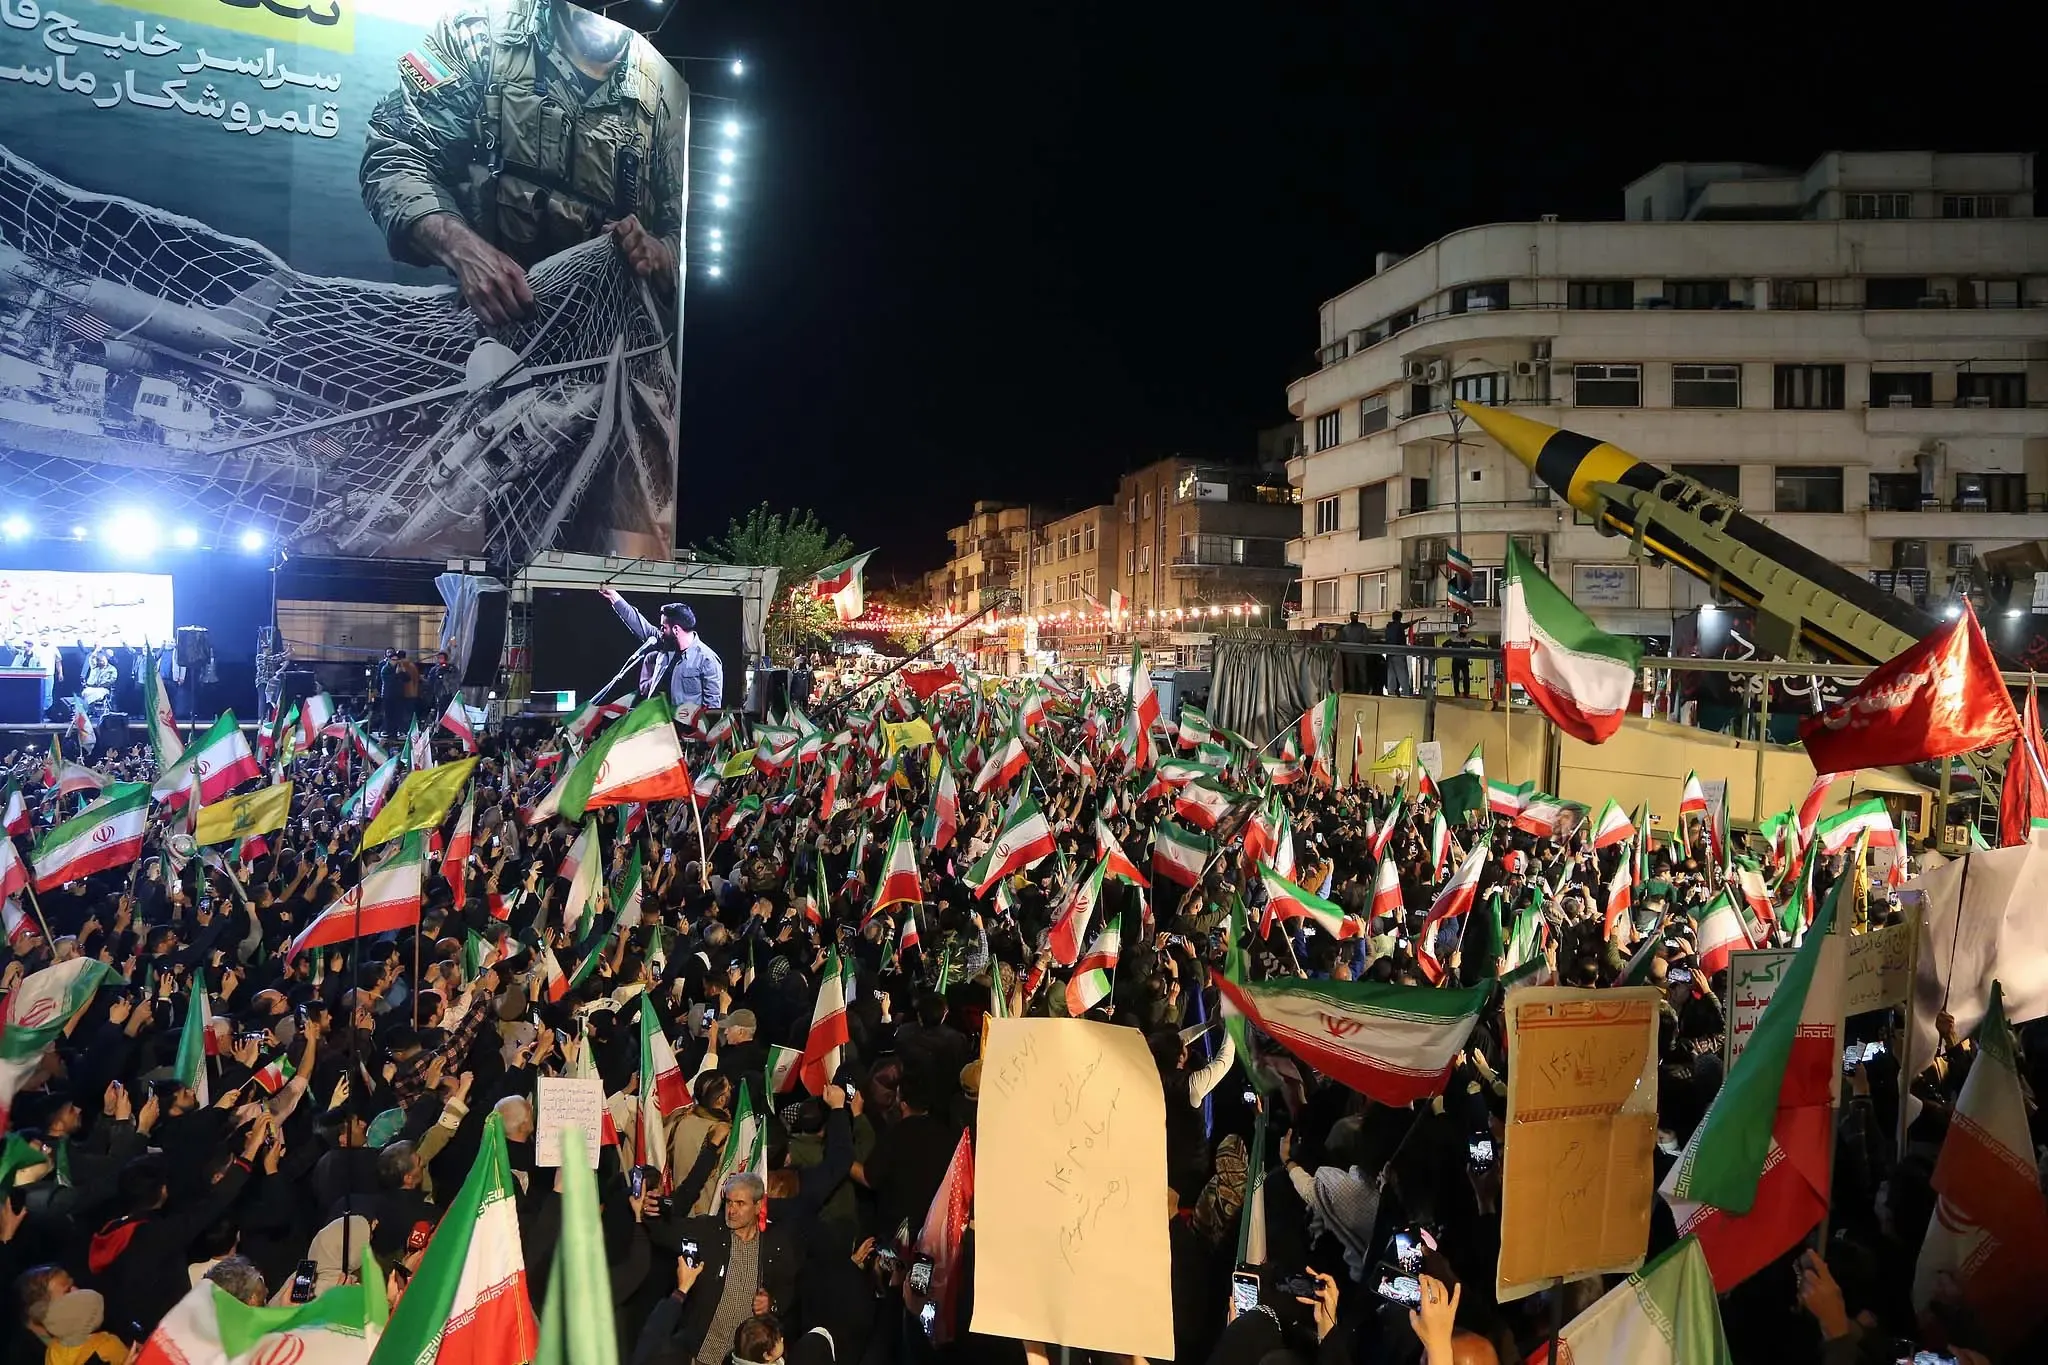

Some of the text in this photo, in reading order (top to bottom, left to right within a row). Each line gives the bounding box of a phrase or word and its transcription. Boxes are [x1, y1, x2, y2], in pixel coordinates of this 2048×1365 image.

[43, 10, 183, 58] خلیج
[178, 48, 342, 91] سراسر
[93, 69, 227, 119] شکار
[222, 101, 340, 138] قلمرو
[1736, 956, 1786, 989] أكبر
